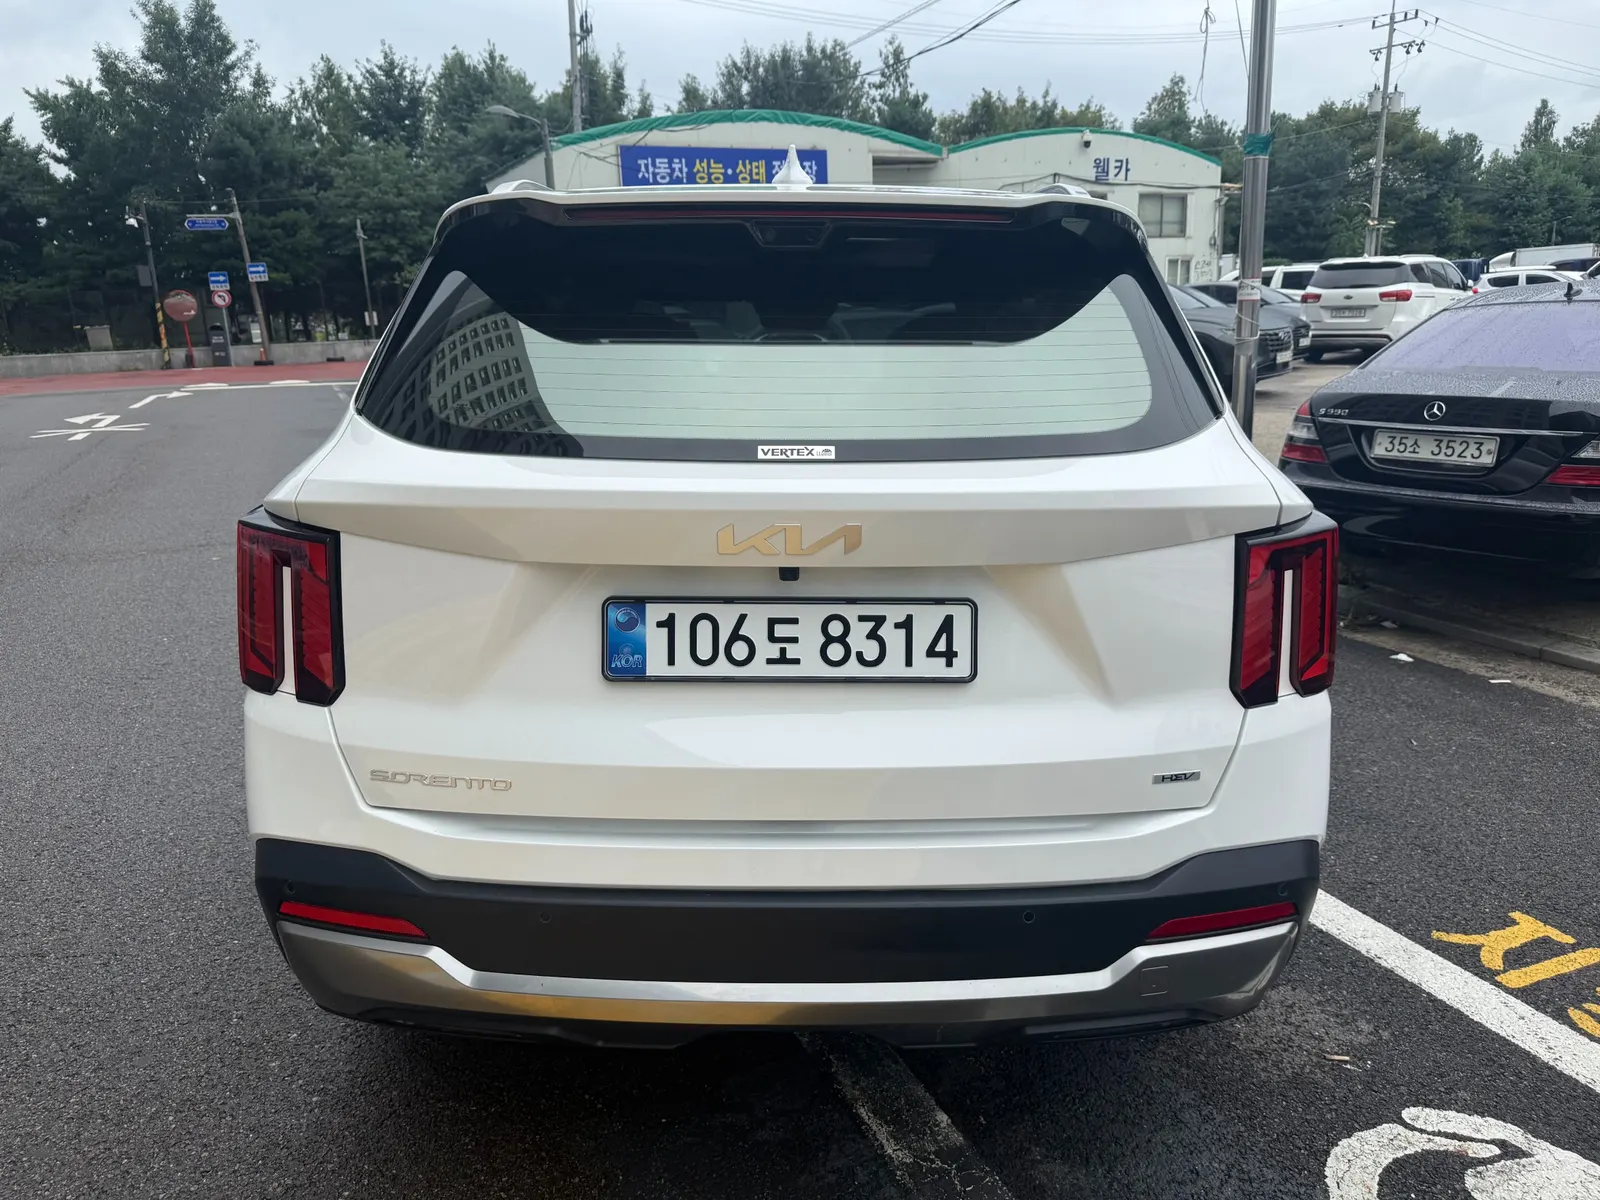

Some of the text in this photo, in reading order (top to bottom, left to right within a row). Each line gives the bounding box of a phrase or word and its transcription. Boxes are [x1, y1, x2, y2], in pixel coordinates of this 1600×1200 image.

[637, 157, 689, 184] 자동차
[760, 446, 815, 458] VERTEX
[1384, 435, 1484, 460] 35소 3523
[655, 612, 959, 668] 106도 8314
[611, 654, 644, 668] KOR
[370, 769, 512, 791] SORENTO
[1161, 772, 1196, 782] HEV
